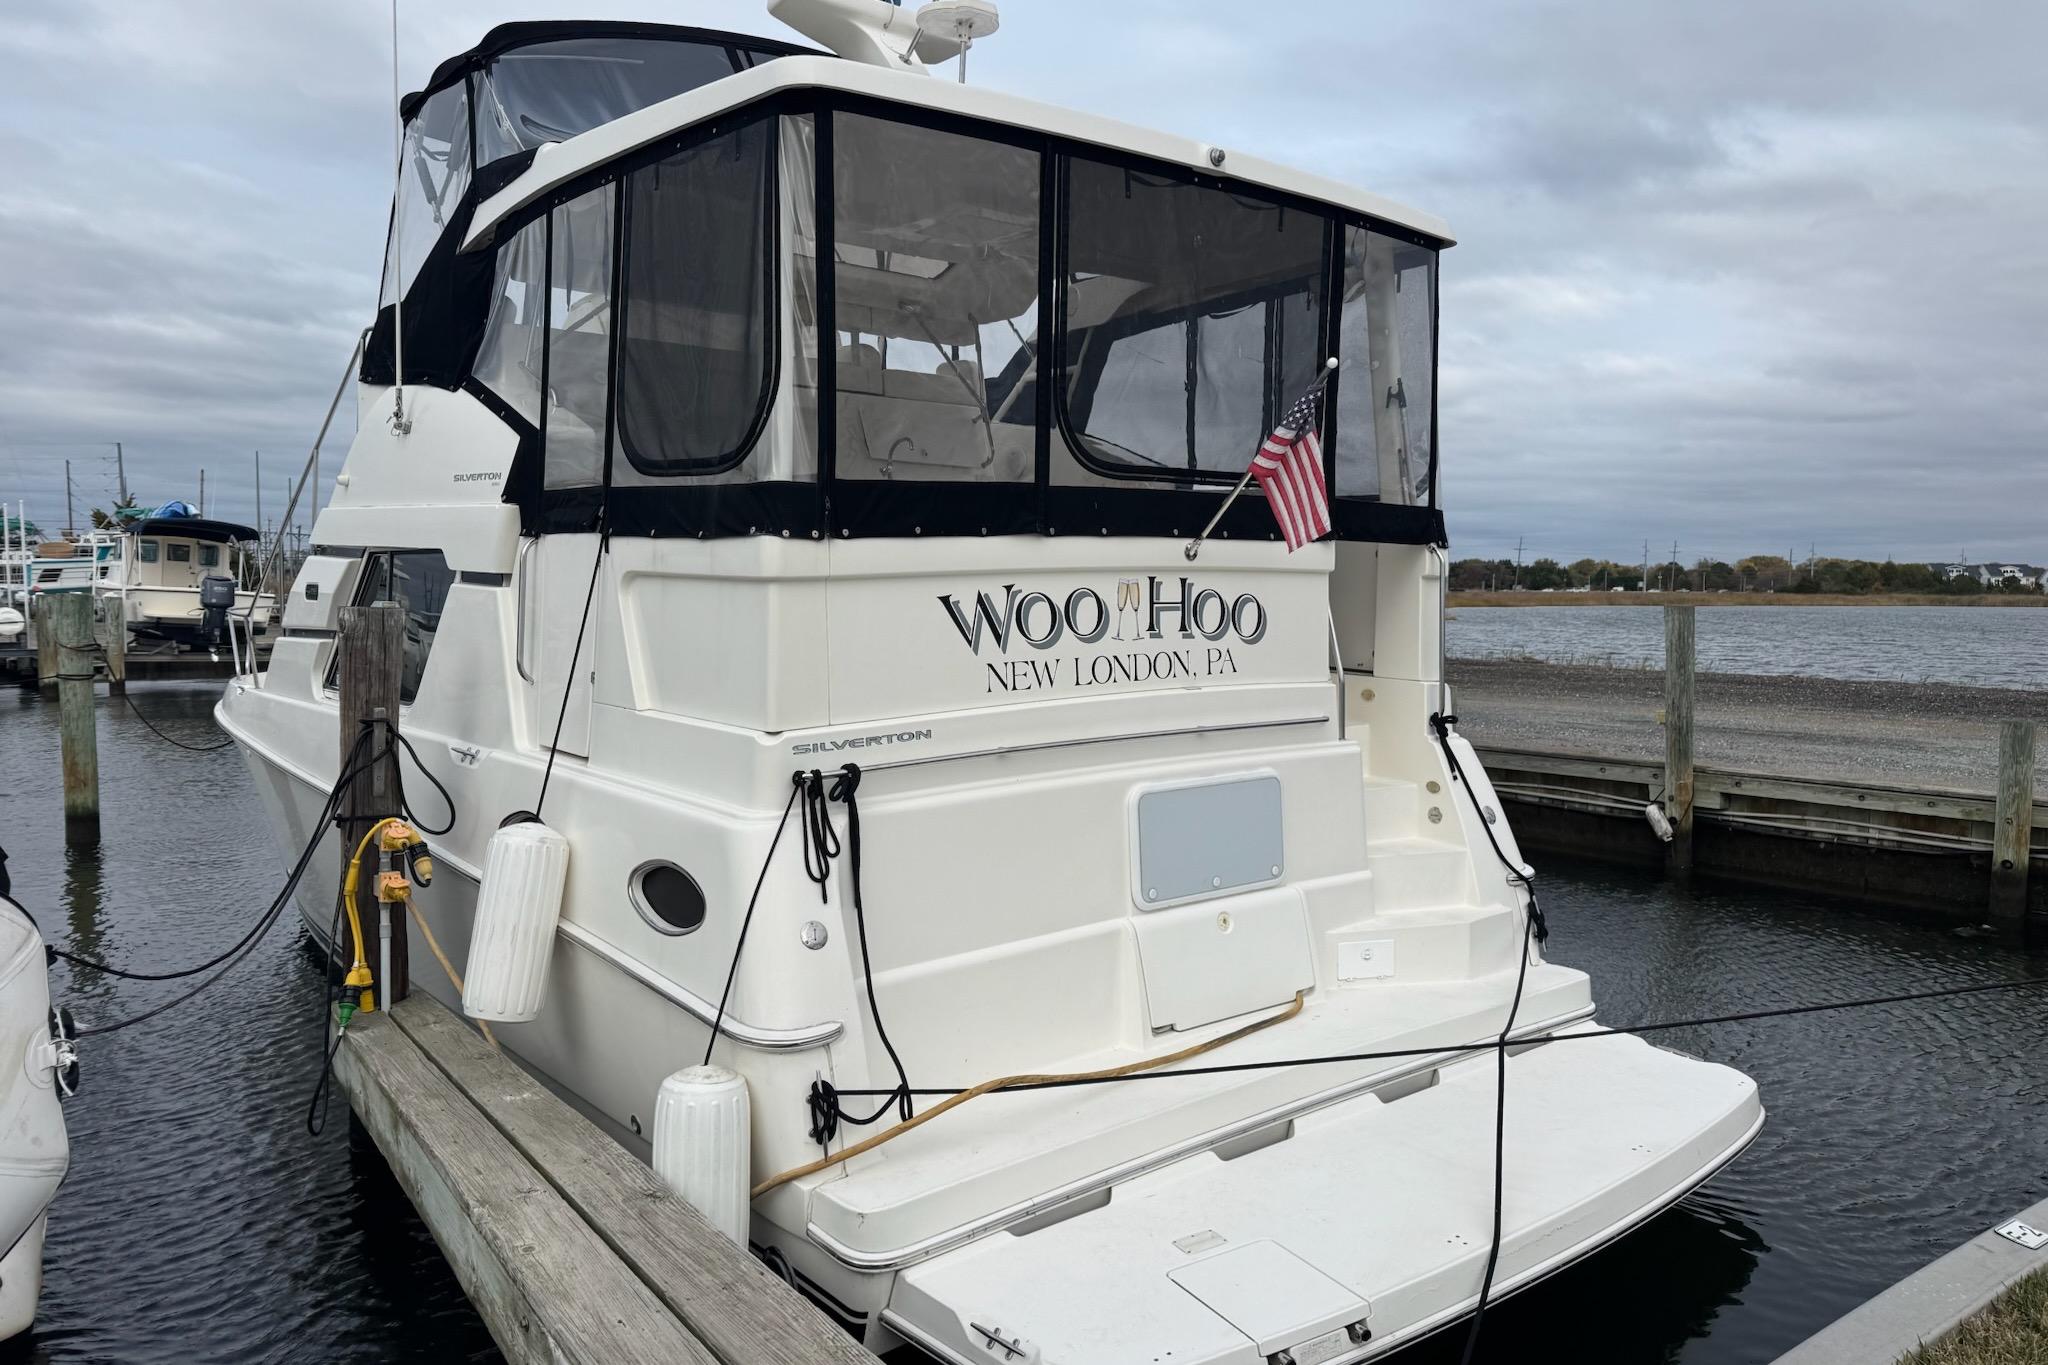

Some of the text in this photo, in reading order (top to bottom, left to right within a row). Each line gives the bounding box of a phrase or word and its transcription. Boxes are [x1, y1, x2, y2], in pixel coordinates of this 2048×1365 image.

[453, 471, 502, 482] SILVERTON
[986, 648, 1238, 693] NEW LONDON, PA
[792, 729, 932, 755] SILVERTON
